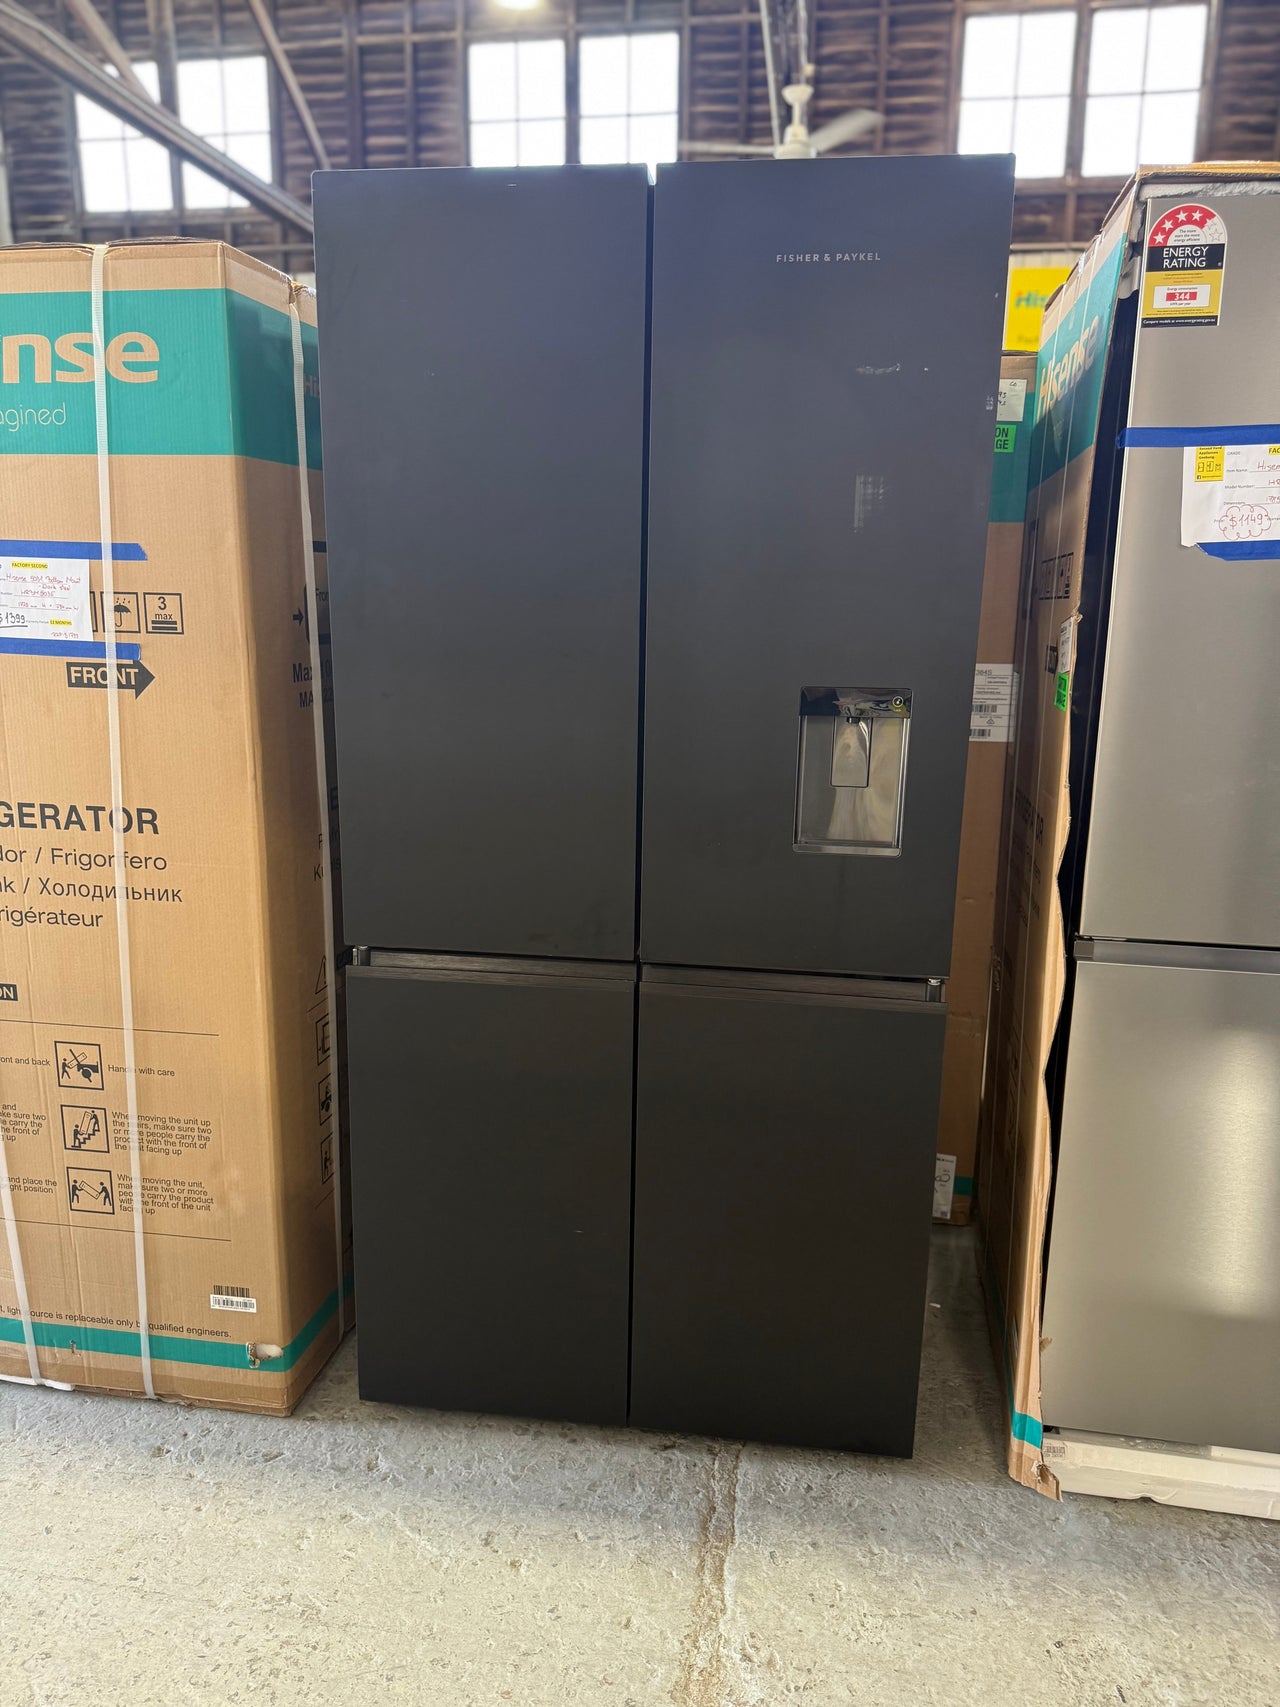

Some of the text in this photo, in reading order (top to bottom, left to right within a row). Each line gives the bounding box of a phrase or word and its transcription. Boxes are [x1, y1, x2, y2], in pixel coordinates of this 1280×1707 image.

[776, 252, 881, 263] FISHER & PAYKEL
[1163, 246, 1209, 258] ENERGY
[1163, 258, 1206, 269] RATING
[1174, 293, 1190, 301] 344
[1037, 315, 1099, 423] Hisense
[1229, 513, 1263, 530] $1149
[157, 596, 167, 611] 3
[70, 666, 139, 685] FRONT
[299, 690, 314, 708] MA
[0, 801, 159, 834] GERATOR
[51, 847, 167, 871] Frigorfero
[15, 1057, 29, 1065] and
[32, 1057, 50, 1066] back
[108, 1064, 175, 1077] Han with care
[2, 1103, 16, 1111] and
[13, 1112, 31, 1120] sure
[33, 1113, 46, 1121] two
[112, 1111, 211, 1127] Whe moving the unit up
[9, 1119, 28, 1129] carry
[30, 1120, 42, 1128] the
[12, 1126, 30, 1135] front
[32, 1127, 40, 1136] of
[112, 1119, 212, 1134] the irs, make sure two
[6, 1134, 16, 1142] up
[114, 1135, 207, 1149] proct with the front of
[123, 1129, 144, 1137] me
[146, 1130, 173, 1141] people
[175, 1132, 196, 1142] carry
[114, 1142, 182, 1156] the it facing up
[22, 1176, 43, 1186] place
[45, 1178, 57, 1187] the
[117, 1173, 205, 1189] Wh moving the unit,
[23, 1184, 54, 1194] position
[118, 1182, 139, 1190] mak
[141, 1184, 159, 1192] sure
[161, 1185, 175, 1194] two
[187, 1188, 208, 1197] more
[118, 1190, 214, 1206] peoe carry the product
[138, 1198, 150, 1207] he
[151, 1200, 169, 1209] front
[171, 1201, 179, 1209] of
[181, 1202, 194, 1210] the
[196, 1203, 211, 1212] unit
[119, 1204, 155, 1216] faci up
[7, 1305, 22, 1316] ligh
[27, 1309, 54, 1319] ource
[56, 1311, 63, 1319] is
[65, 1313, 114, 1325] replaceable
[116, 1318, 133, 1329] only
[136, 1320, 147, 1331] b
[148, 1322, 184, 1333] qualified
[186, 1326, 232, 1338] engineers.
